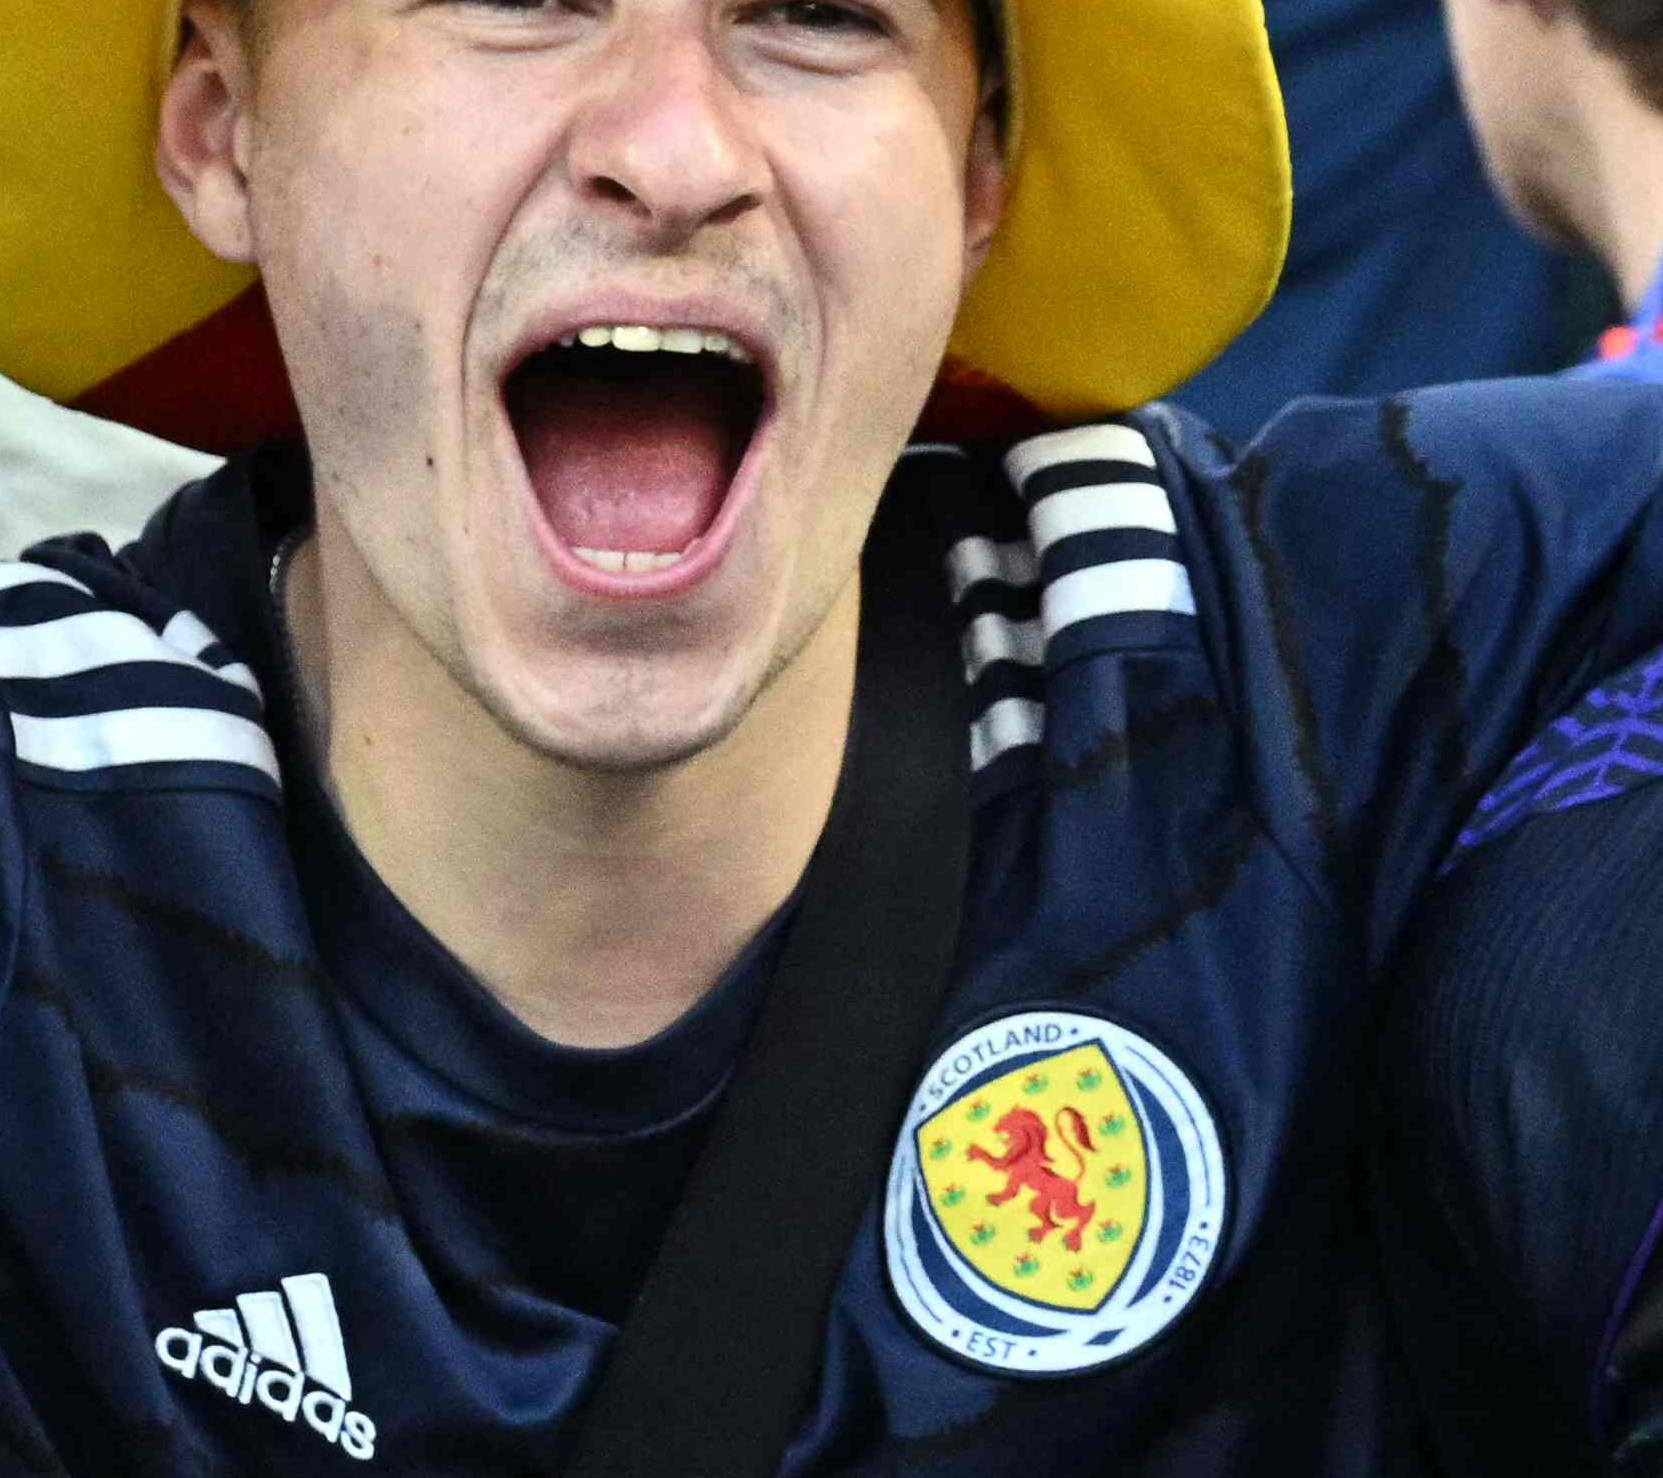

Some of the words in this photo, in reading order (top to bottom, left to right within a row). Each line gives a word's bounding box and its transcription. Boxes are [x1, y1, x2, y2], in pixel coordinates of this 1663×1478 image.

[929, 1023, 1062, 1098] SCOTLAND
[1169, 1235, 1211, 1291] 1873
[965, 1331, 1017, 1360] EST
[155, 1327, 377, 1460] adidas
